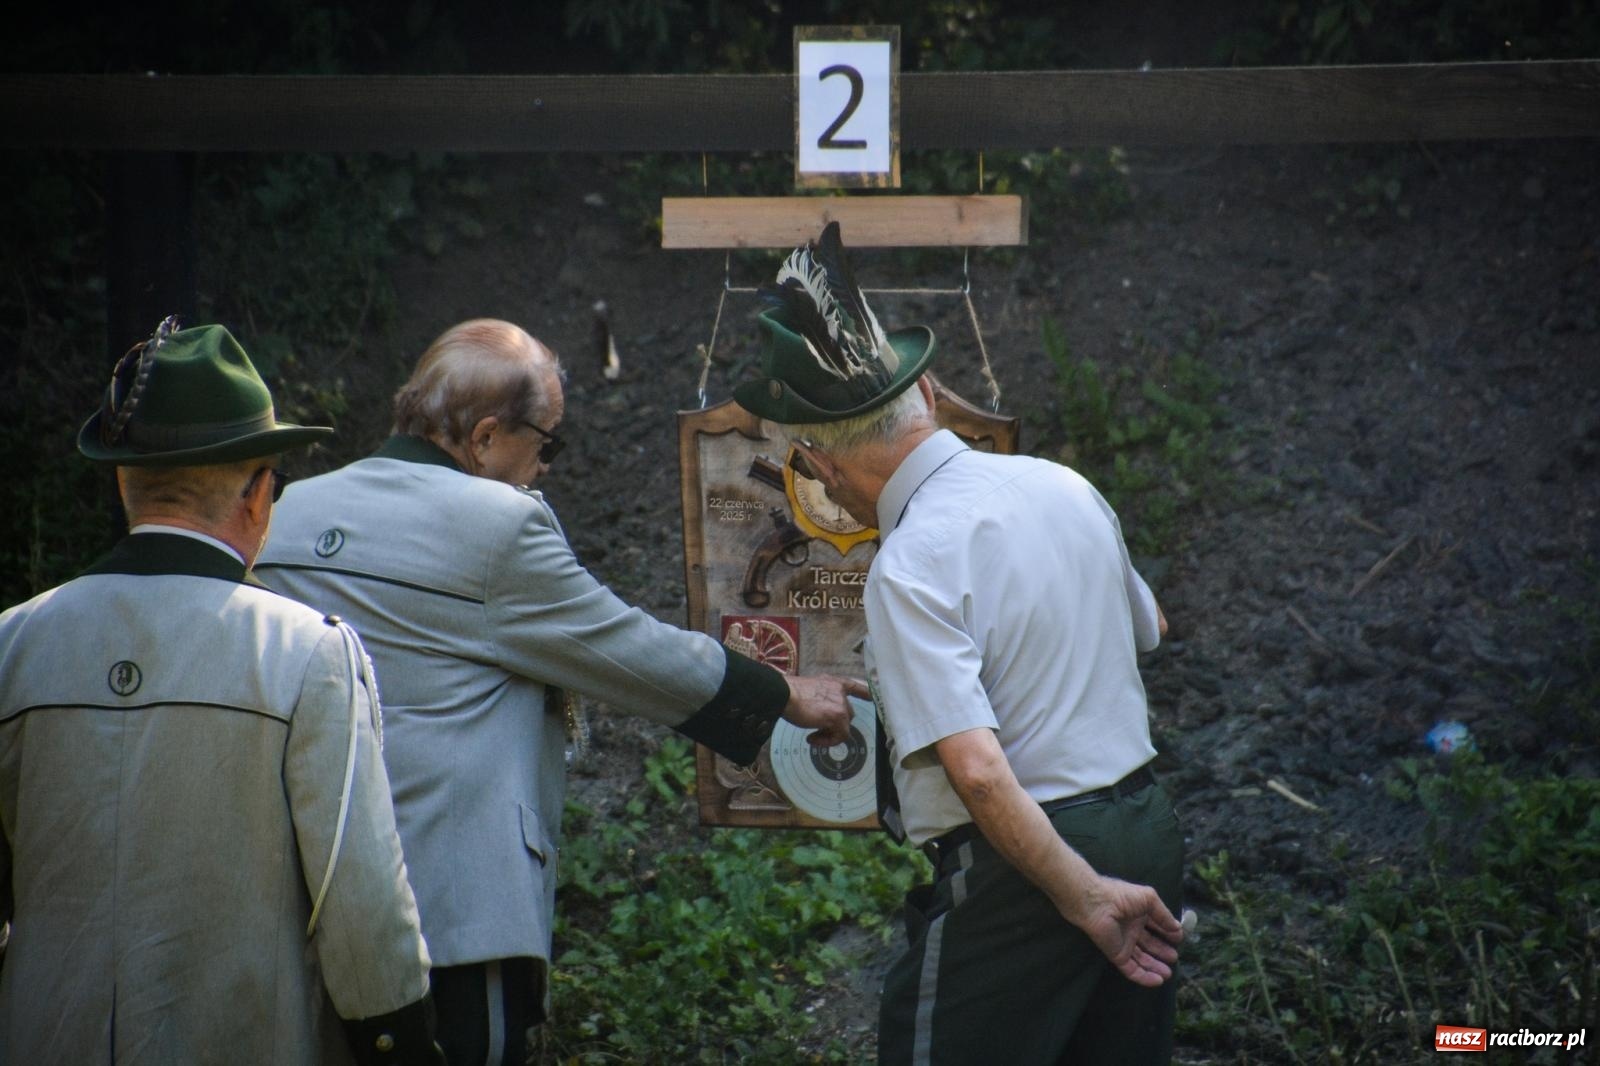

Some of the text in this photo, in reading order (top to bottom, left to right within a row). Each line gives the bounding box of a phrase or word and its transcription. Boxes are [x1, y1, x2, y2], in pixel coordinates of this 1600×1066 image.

[817, 64, 868, 149] 2
[710, 498, 764, 509] 22 czerwca
[720, 511, 745, 521] 2025
[810, 567, 868, 585] Tarcza
